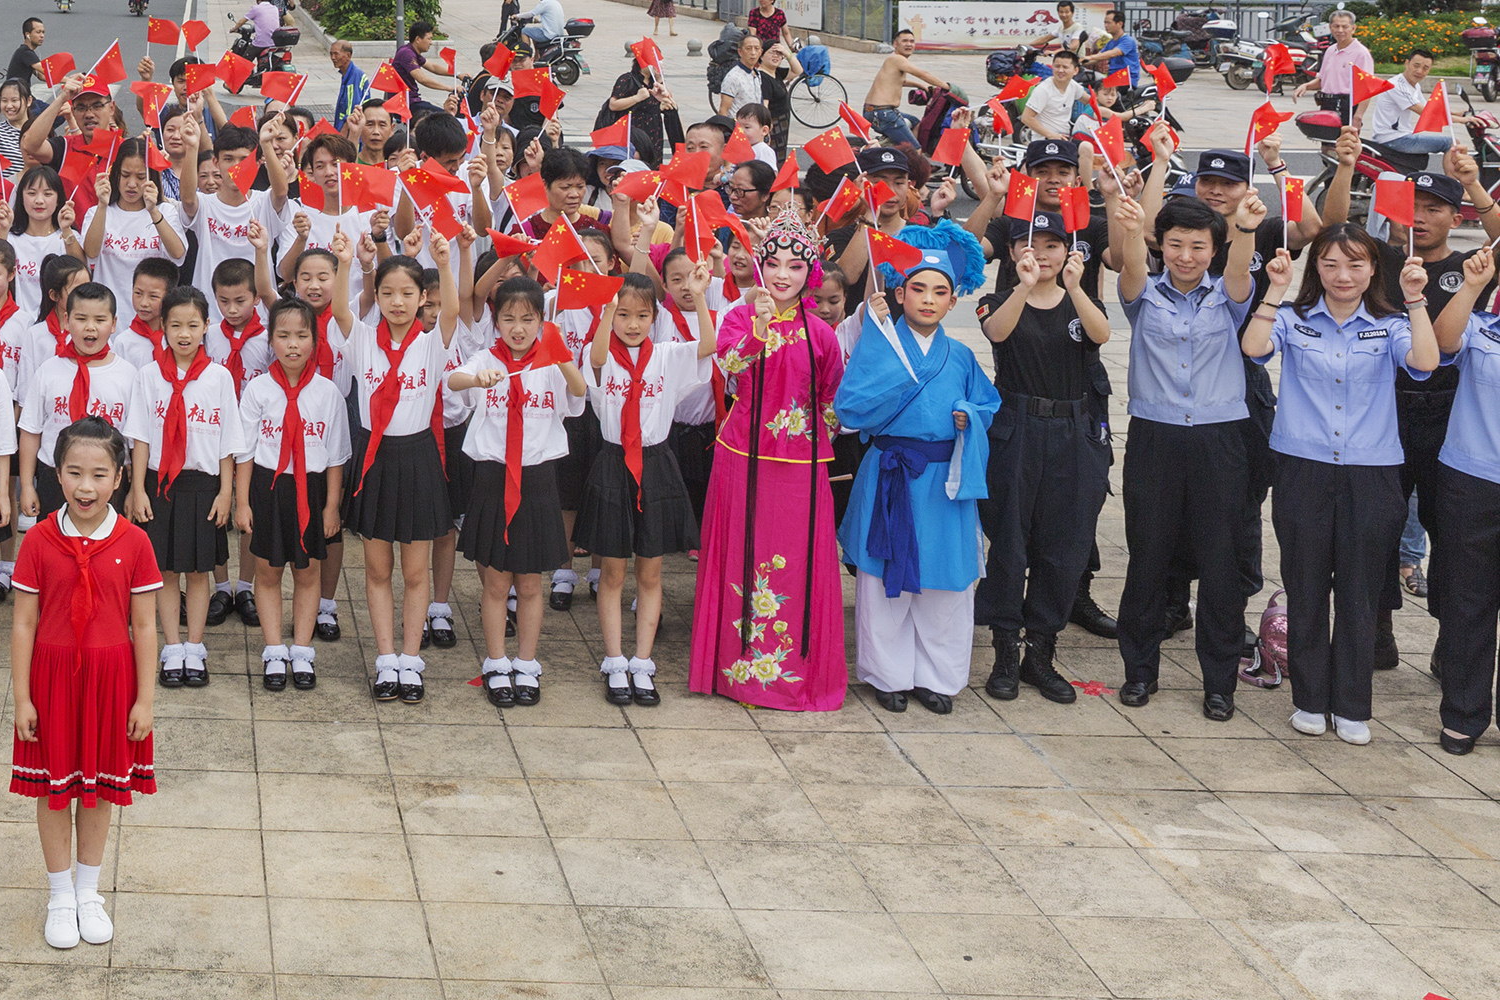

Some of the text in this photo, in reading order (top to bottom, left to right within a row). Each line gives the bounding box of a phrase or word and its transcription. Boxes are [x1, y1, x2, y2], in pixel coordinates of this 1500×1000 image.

[54, 396, 125, 423] 歌祖国
[485, 388, 556, 412] 歌祖国
[261, 418, 327, 441] 歌祖国
